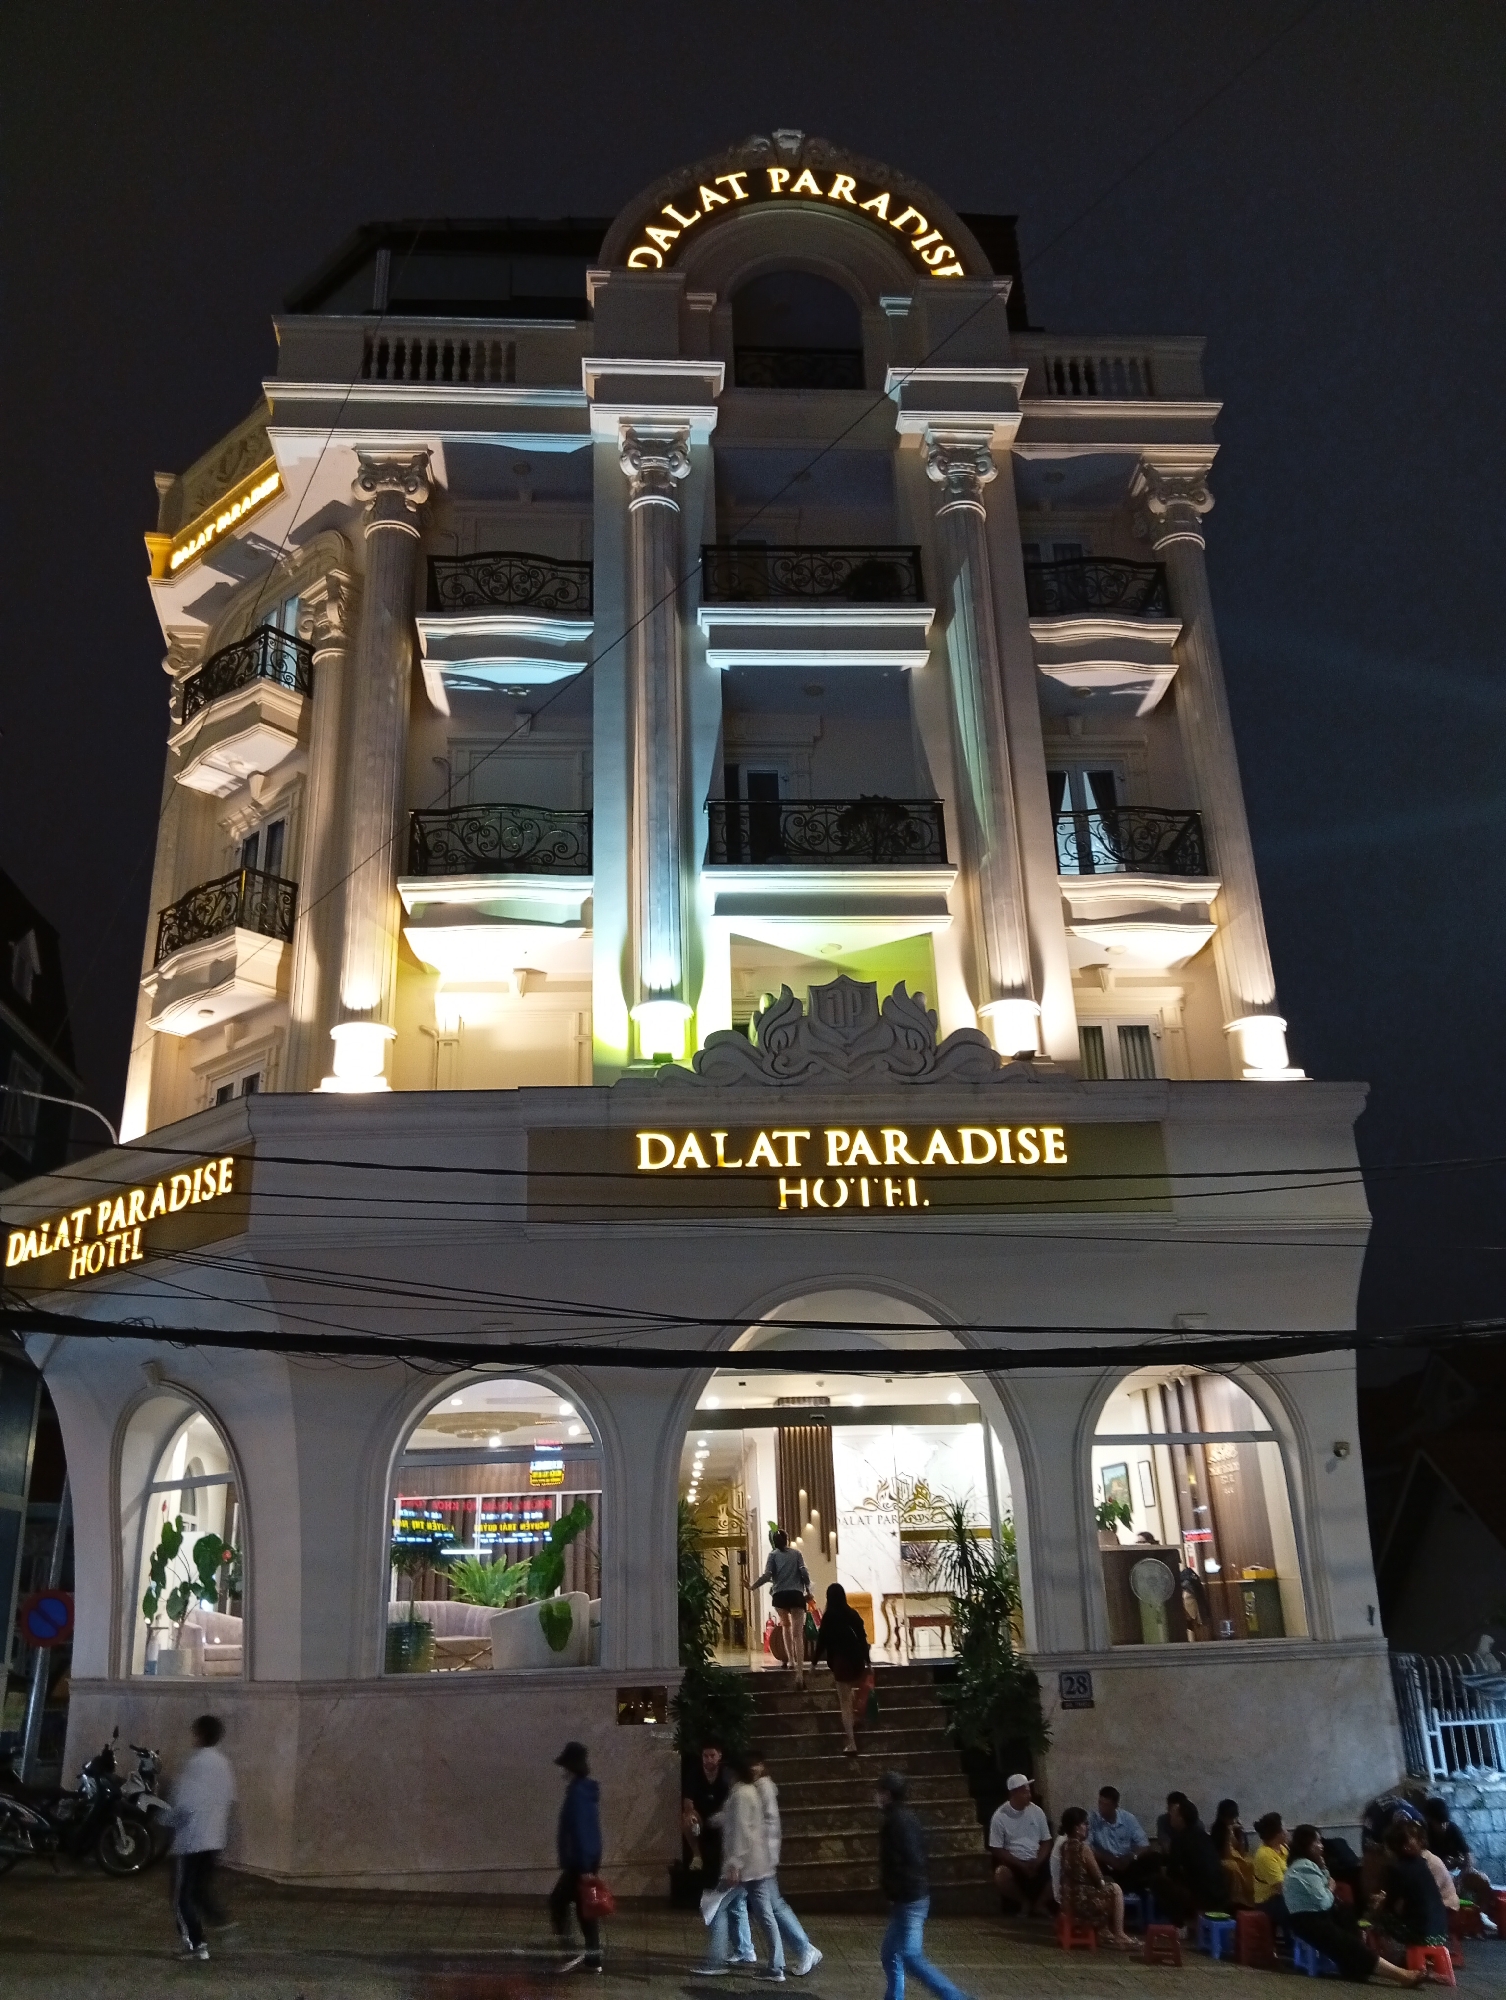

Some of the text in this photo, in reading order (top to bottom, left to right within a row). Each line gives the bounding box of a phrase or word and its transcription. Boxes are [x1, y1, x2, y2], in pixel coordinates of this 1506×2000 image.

[627, 172, 748, 269] DALAT
[636, 1127, 1068, 1170] DALAT PARADISE
[5, 1157, 234, 1267] DALAT PARADISE
[778, 1177, 930, 1210] HOTEL
[68, 1227, 143, 1280] HOTEL
[1064, 1675, 1088, 1695] 28
